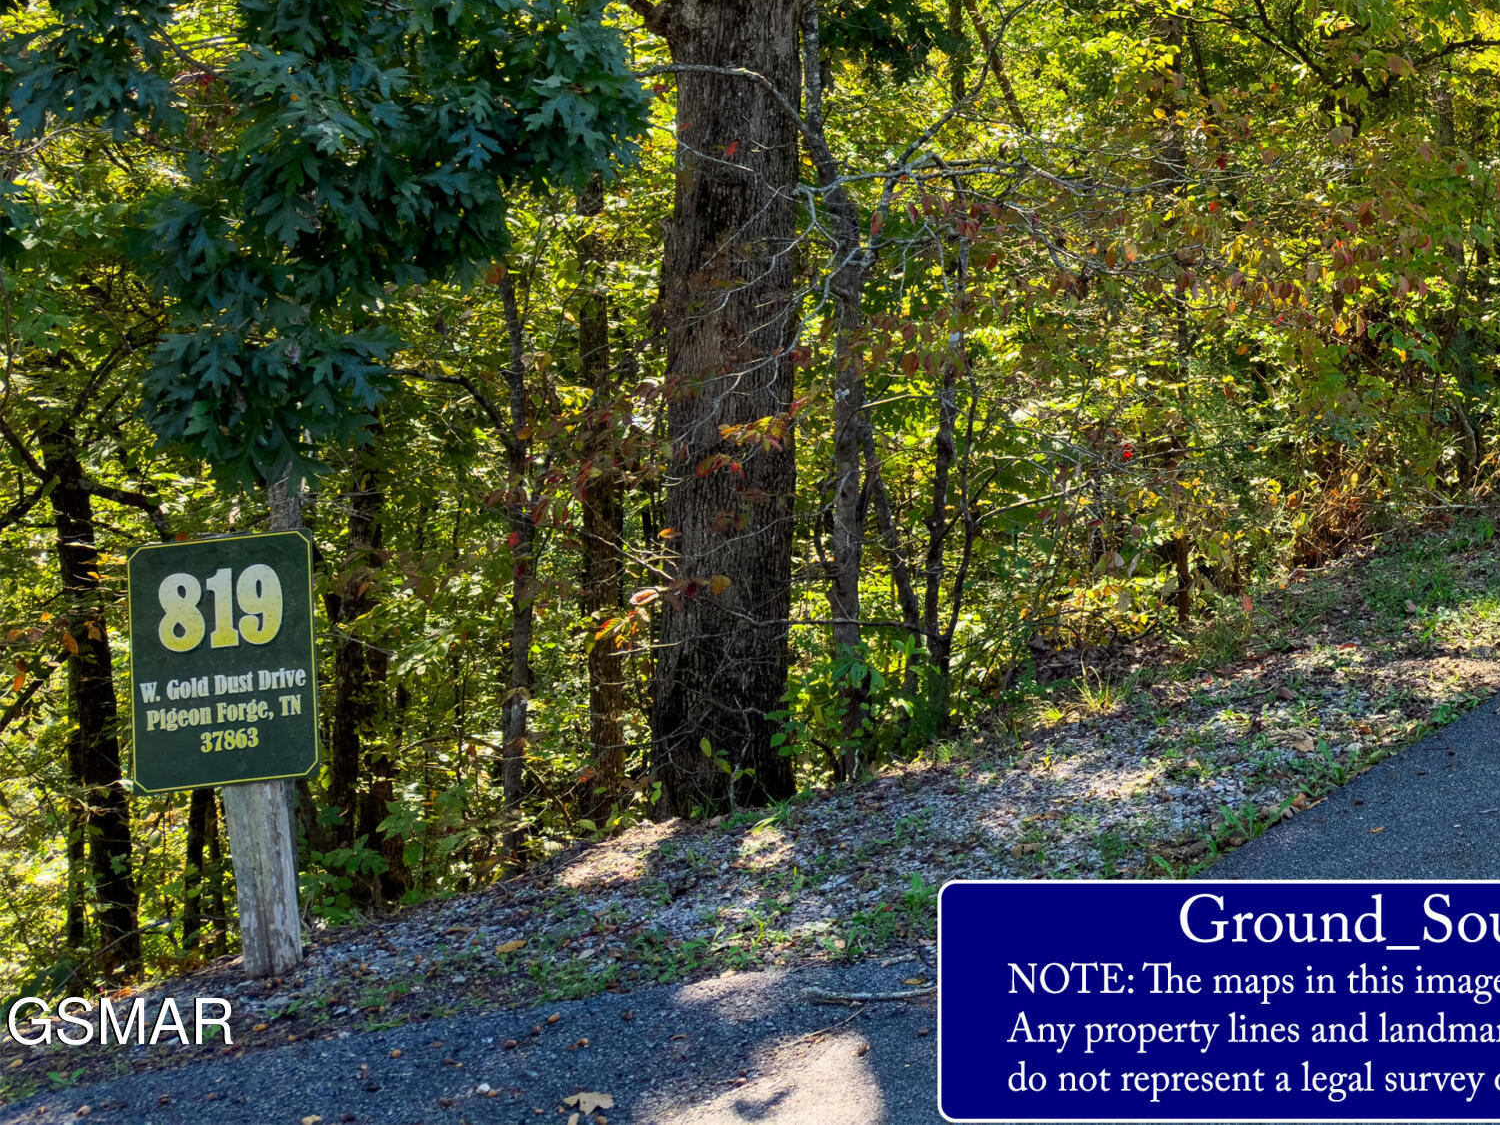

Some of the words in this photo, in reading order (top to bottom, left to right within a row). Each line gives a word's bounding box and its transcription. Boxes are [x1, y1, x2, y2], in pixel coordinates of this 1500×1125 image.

[157, 563, 283, 653] 819
[139, 681, 161, 704] W.
[166, 676, 209, 701] Gold
[214, 671, 254, 696] Dust
[257, 667, 307, 692] Drive
[146, 706, 213, 732] Pigeon
[216, 699, 275, 724] Forge,
[278, 694, 302, 717] TN
[200, 727, 259, 754] 37863
